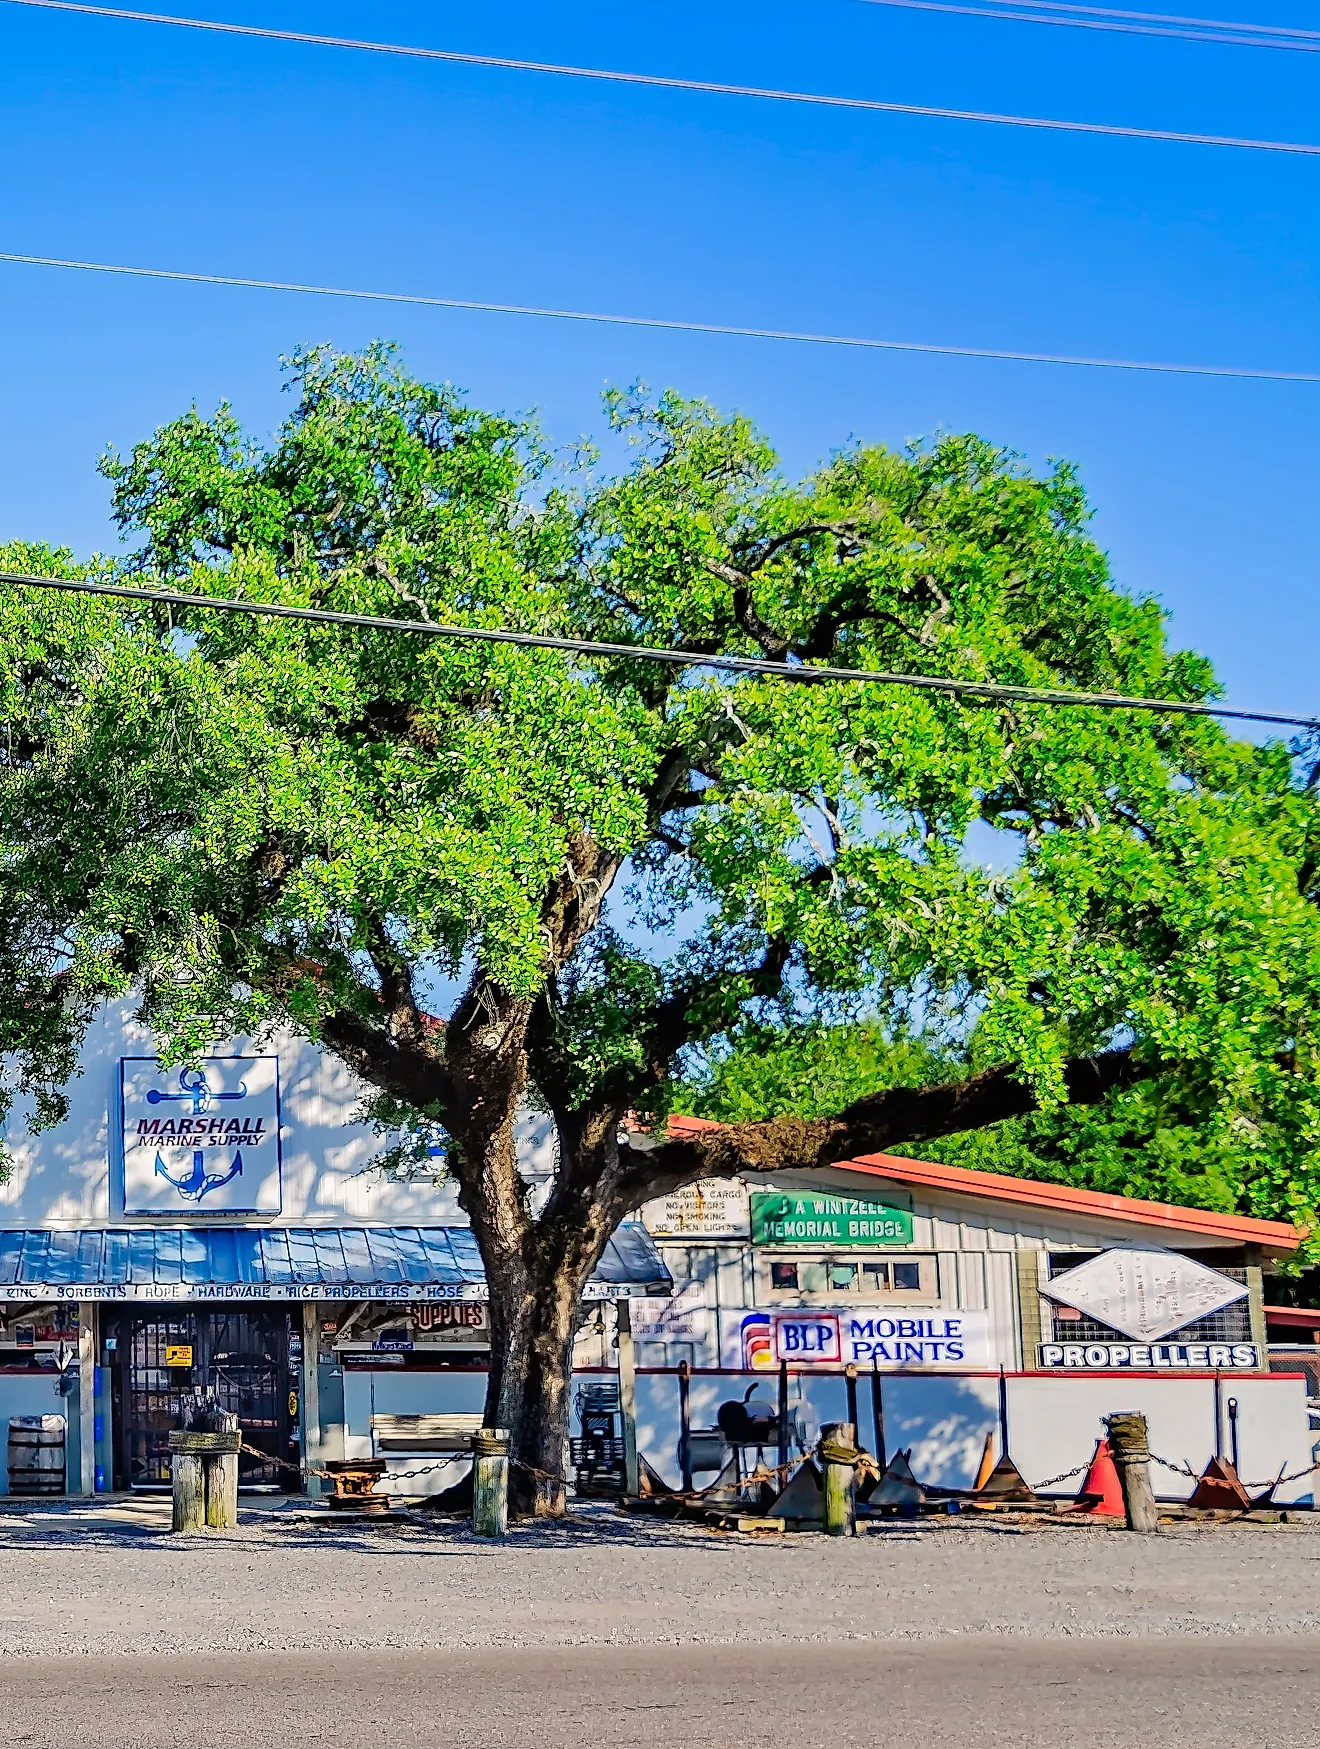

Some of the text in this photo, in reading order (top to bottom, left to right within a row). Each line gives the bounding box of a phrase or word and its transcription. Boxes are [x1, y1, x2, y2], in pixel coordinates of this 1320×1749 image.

[136, 1117, 267, 1135] MARSHALL
[138, 1135, 263, 1147] MARINE SUPPLY
[795, 1201, 805, 1215] A
[764, 1221, 904, 1238] MEMORIAL BRIDGE
[198, 1286, 271, 1298] HARDWARE
[325, 1285, 409, 1298] PROPELLERS
[427, 1285, 463, 1297] HOSE
[851, 1318, 961, 1338] MOBILE
[782, 1323, 833, 1352] BLP
[852, 1341, 964, 1361] PAINTS
[1043, 1345, 1257, 1367] PROPELLERS
